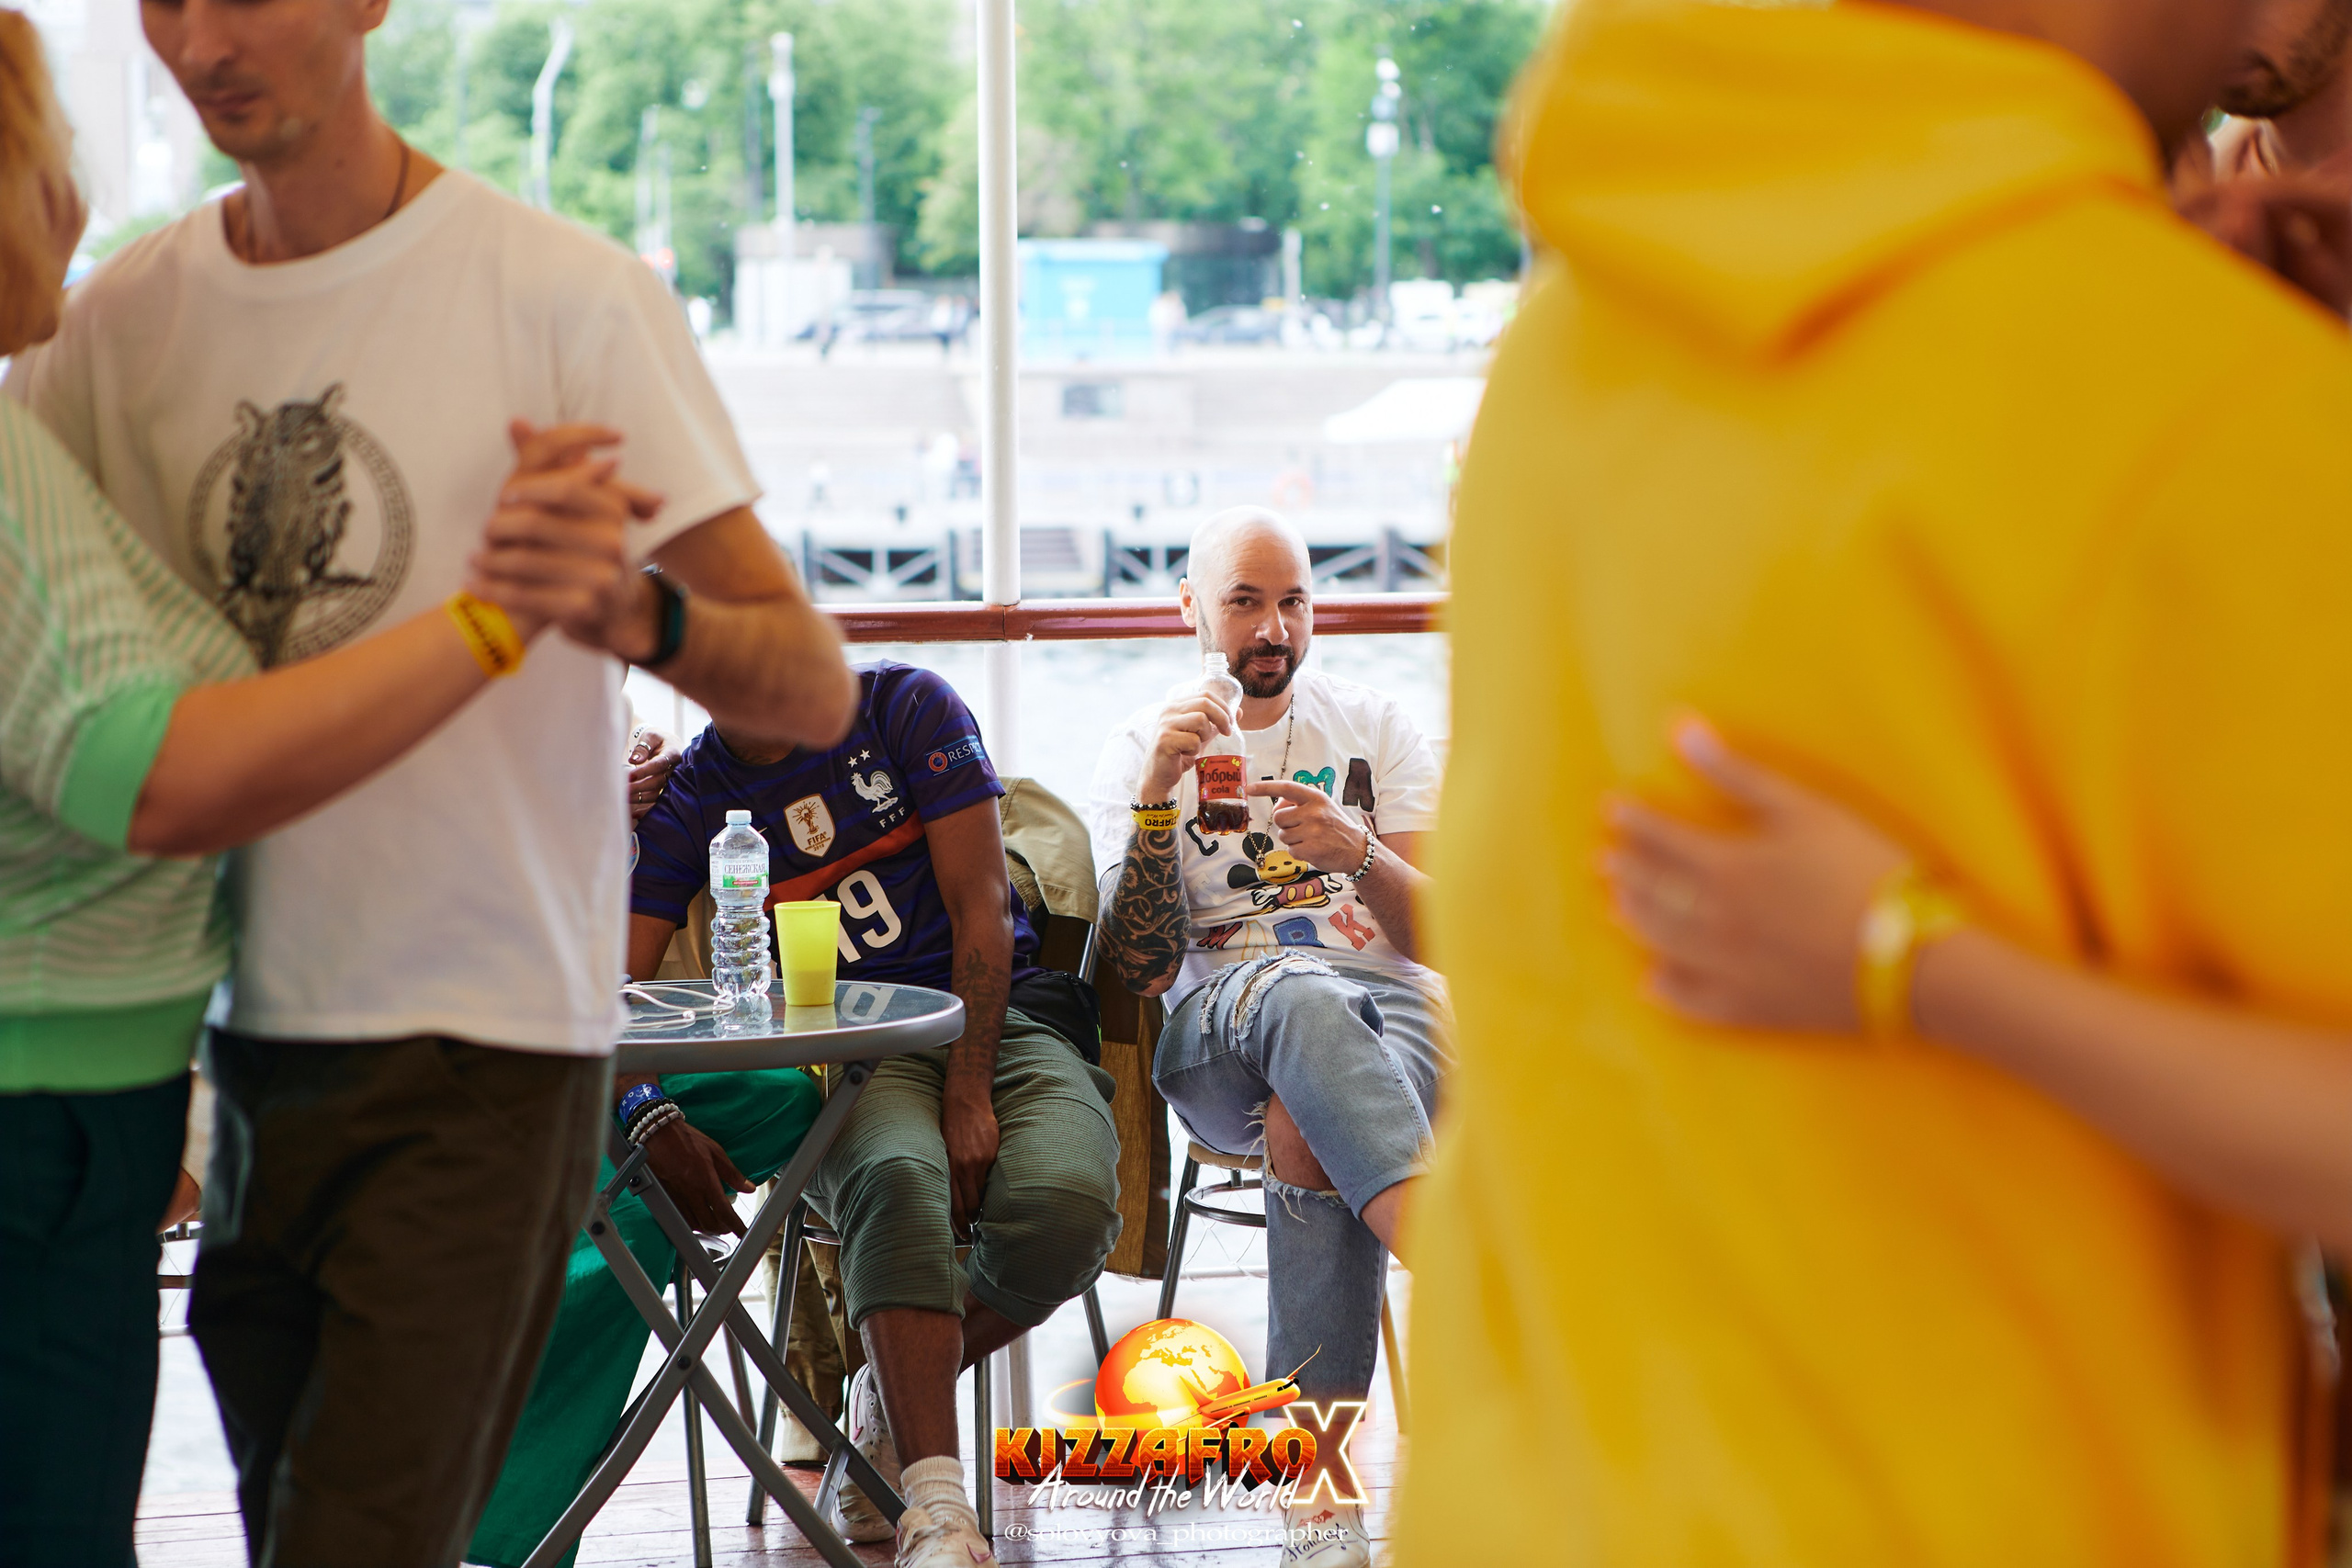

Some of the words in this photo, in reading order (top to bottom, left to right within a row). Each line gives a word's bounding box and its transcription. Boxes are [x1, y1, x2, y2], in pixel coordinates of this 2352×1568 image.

[947, 741, 980, 762] RESP
[1199, 768, 1241, 784] Добрый
[1211, 785, 1230, 795] cola
[807, 832, 826, 846] FIFA
[724, 863, 766, 874] СЕНЕЖСКАЯ
